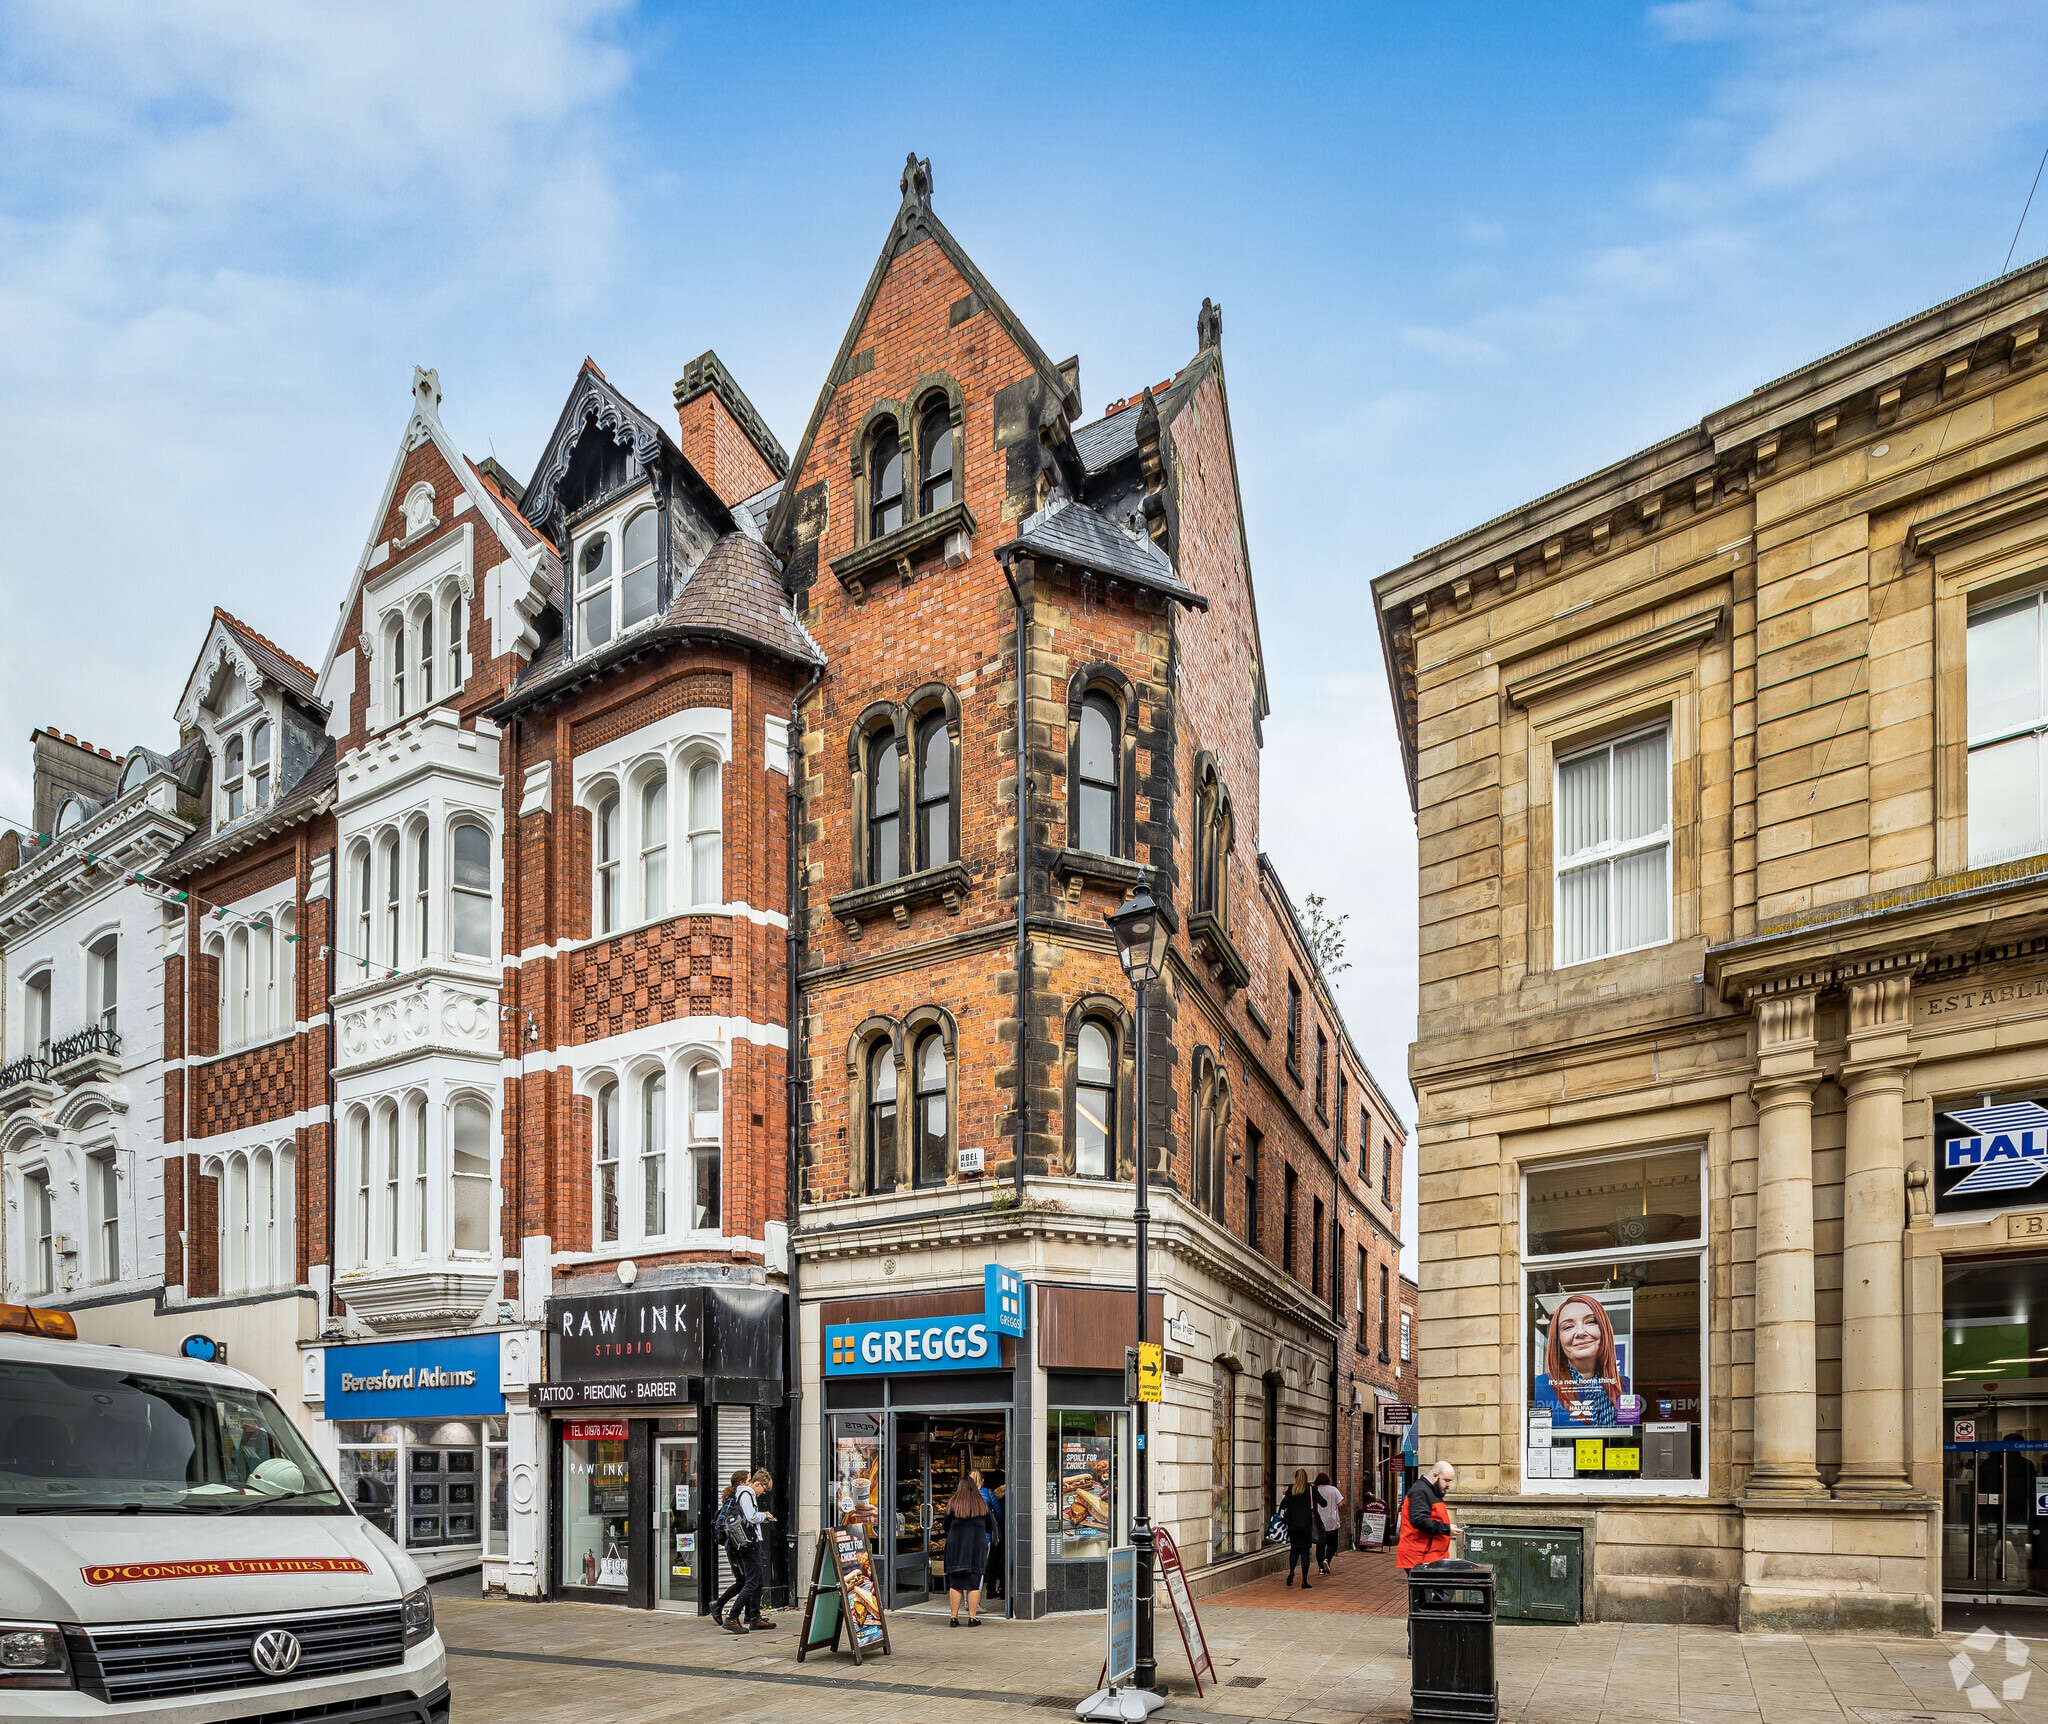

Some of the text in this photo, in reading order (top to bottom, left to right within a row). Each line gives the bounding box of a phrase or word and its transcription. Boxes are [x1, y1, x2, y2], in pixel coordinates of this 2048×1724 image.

[1948, 1130, 2048, 1166] HAL
[960, 1153, 977, 1161] ABEL
[563, 1304, 687, 1336] RAW INK
[1000, 1314, 1020, 1329] GREGGS
[595, 1340, 652, 1357] STUDIO
[861, 1324, 989, 1364] GREGGS
[341, 1366, 476, 1392] Beresford Adams
[538, 1382, 677, 1401] TATTOO PIERCING BARBER
[571, 1425, 584, 1437] TEL.
[570, 1463, 623, 1476] RAW INK
[838, 1540, 863, 1552] SPOILT FOR
[601, 1559, 627, 1570] REIGN
[840, 1551, 858, 1562] CHOICE
[92, 1559, 367, 1582] O'CONNOR UTILITIES LTD.
[1112, 1580, 1133, 1597] SUMMER
[1112, 1594, 1133, 1615] DRINKS
